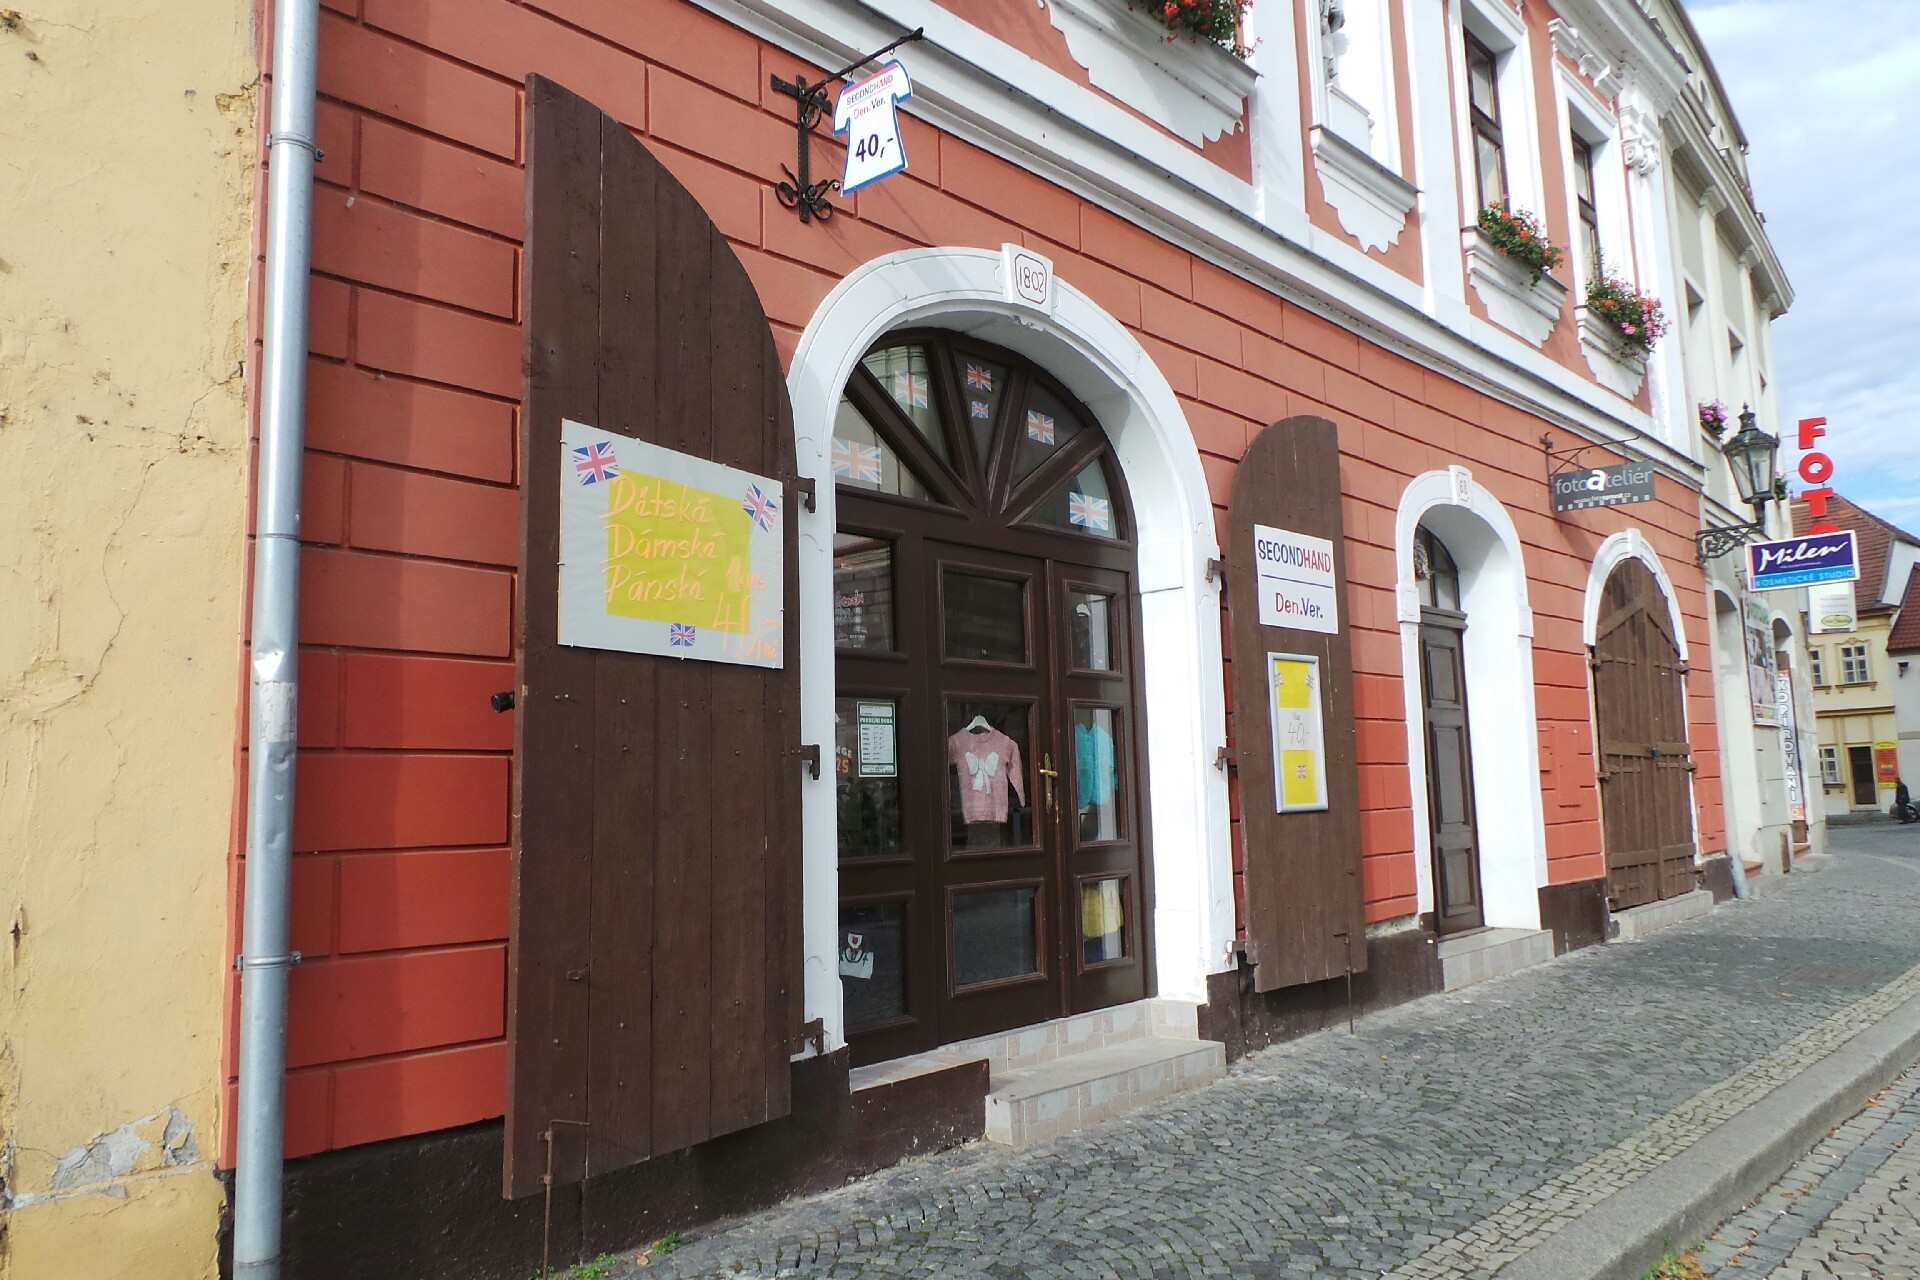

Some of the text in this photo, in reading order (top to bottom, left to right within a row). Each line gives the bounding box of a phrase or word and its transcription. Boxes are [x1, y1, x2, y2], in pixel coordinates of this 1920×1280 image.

[847, 74, 894, 105] SECONDHAND
[855, 133, 894, 162] 40,-
[1019, 266, 1044, 293] 1802
[1555, 467, 1652, 494] fotoateliér
[600, 523, 726, 564] Dámská
[1258, 538, 1331, 573] SECONDHAND
[1758, 541, 1849, 572] Milen
[1819, 569, 1854, 580] STUDIO
